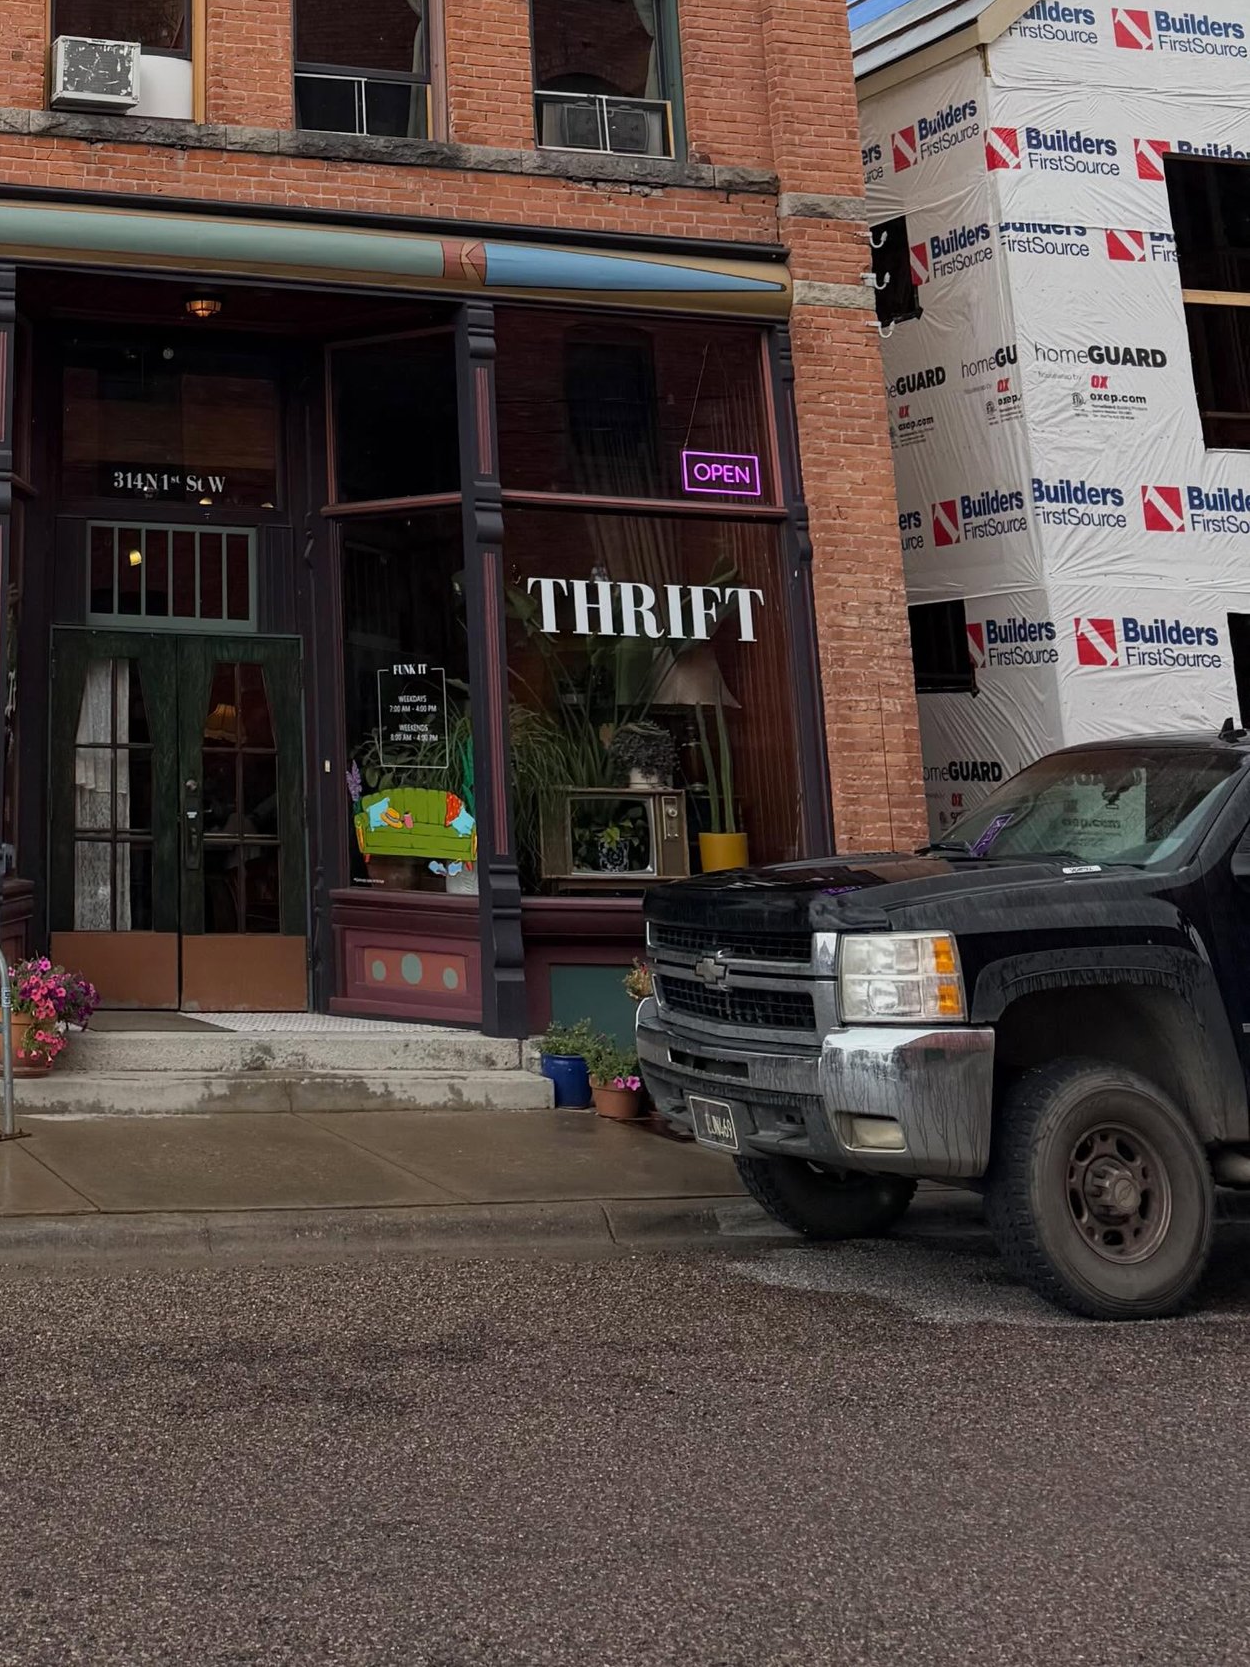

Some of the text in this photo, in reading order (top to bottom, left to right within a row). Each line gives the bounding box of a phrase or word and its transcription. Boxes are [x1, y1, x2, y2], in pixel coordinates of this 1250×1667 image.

[1022, 0, 1096, 25] uilders
[1008, 22, 1098, 45] FirstSource
[1154, 11, 1245, 40] Builders
[1159, 35, 1248, 59] FirstSource
[918, 100, 978, 141] Builders
[920, 123, 980, 161] FirstSource
[1025, 127, 1118, 157] Builders
[1028, 152, 1120, 177] FirstSource
[930, 222, 991, 260] Builders
[933, 246, 993, 280] FirstSource
[1035, 342, 1167, 368] homeGUARD
[1090, 375, 1109, 389] OX
[1089, 392, 1147, 405] oxep.com
[113, 471, 143, 489] 314
[145, 473, 158, 489] N
[186, 475, 205, 492] St
[208, 476, 226, 493] W
[694, 463, 751, 484] OPEN
[961, 489, 1024, 520] Builders
[1031, 477, 1124, 507] Builders
[963, 516, 1027, 541] FirstSource
[527, 577, 765, 642] THRIFT
[985, 617, 1057, 645] Builders
[1122, 617, 1219, 647] Builders
[988, 646, 1059, 666] FirstSource
[1125, 646, 1222, 669] FirstSource
[393, 663, 428, 675] FUNK IT
